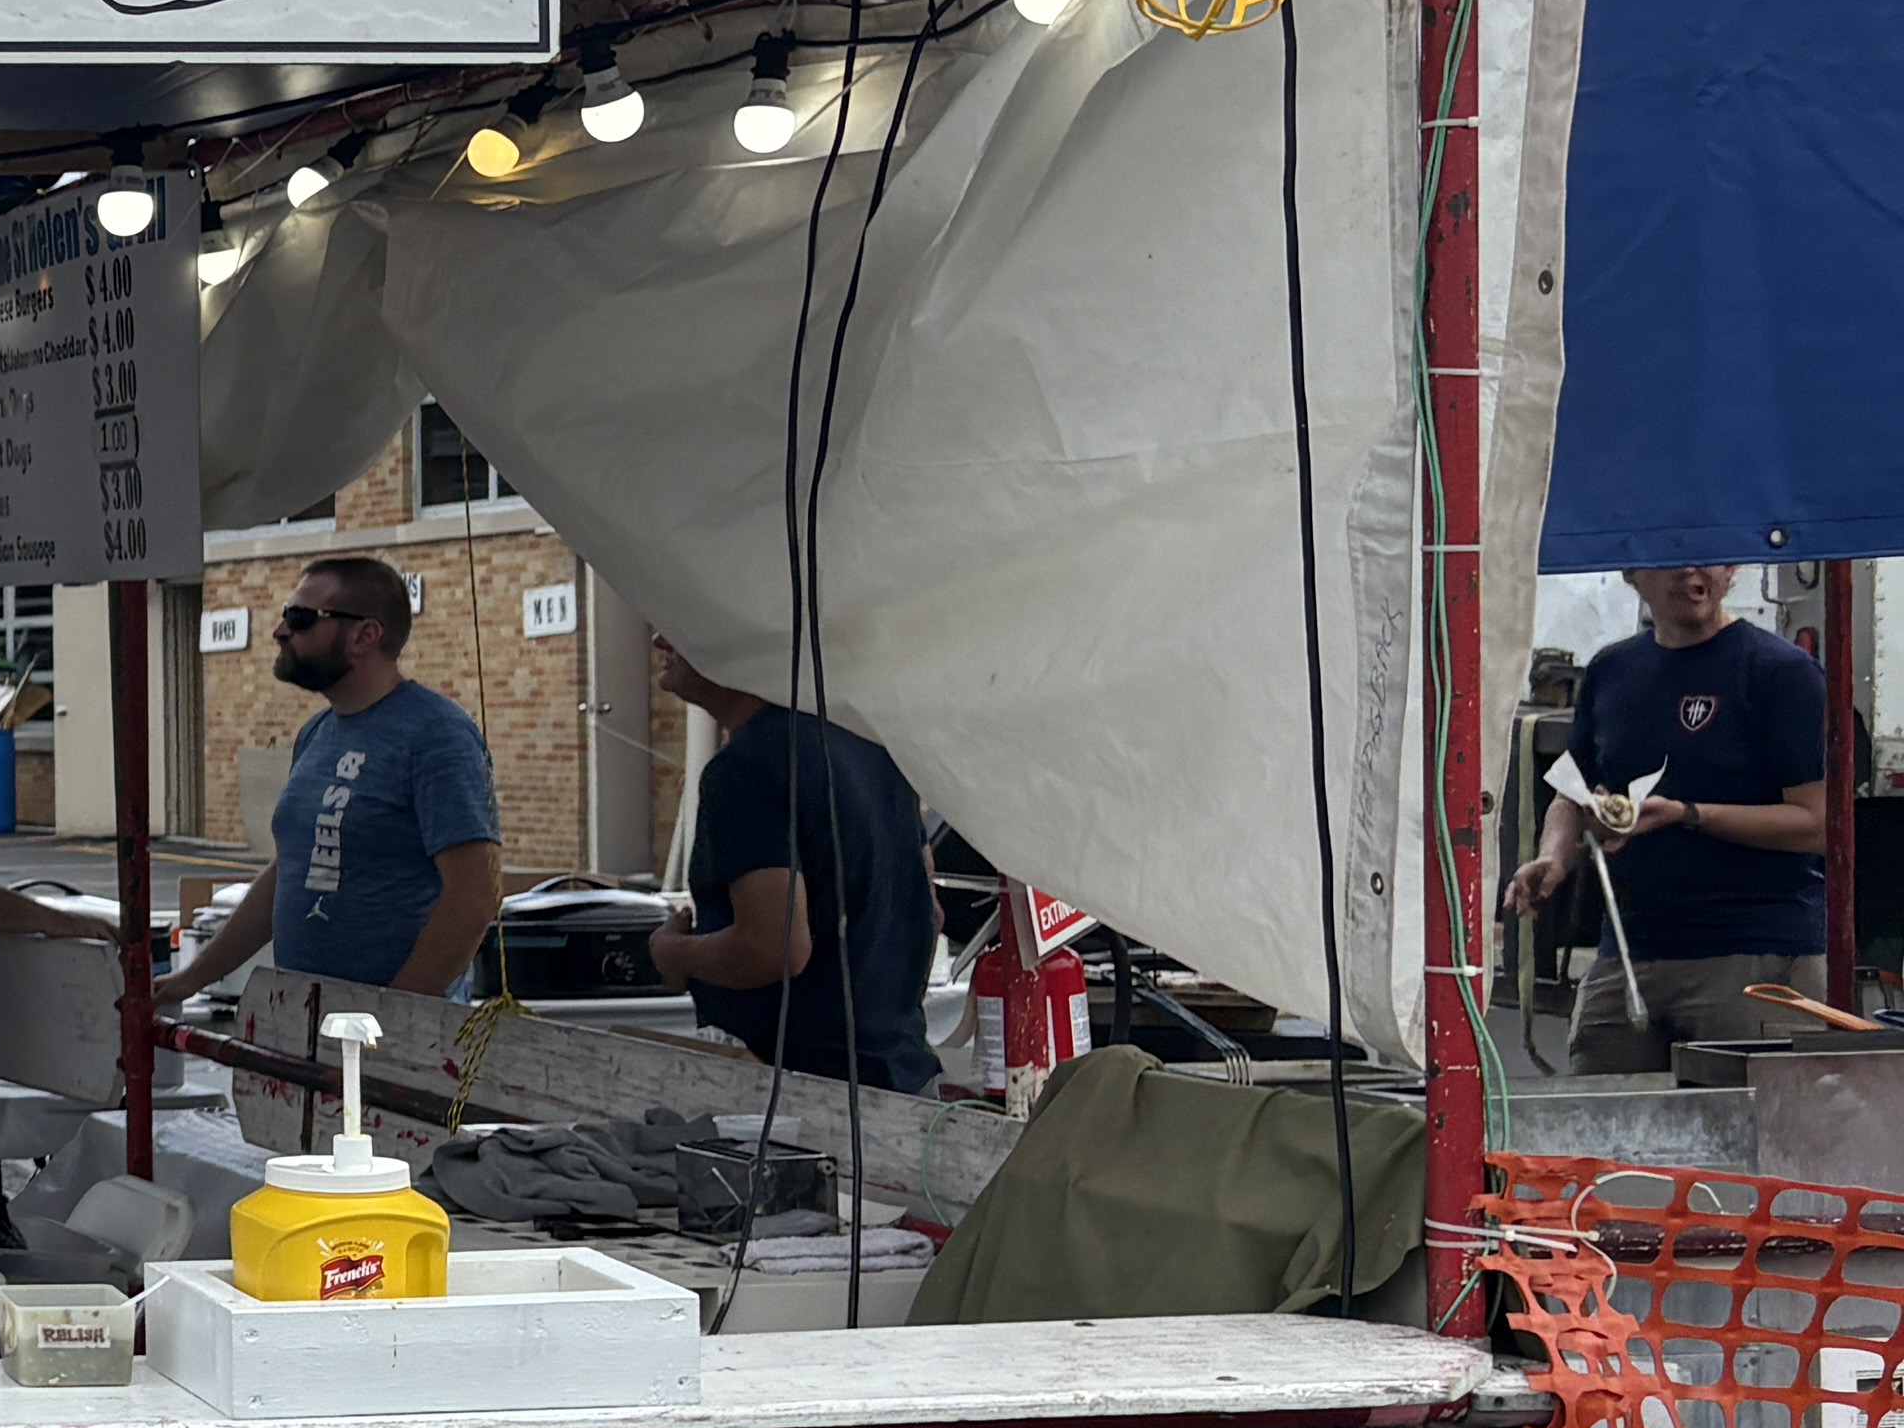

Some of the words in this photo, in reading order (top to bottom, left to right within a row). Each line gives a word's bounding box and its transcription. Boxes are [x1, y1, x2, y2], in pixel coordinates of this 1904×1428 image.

[15, 285, 55, 323] Burgers
[44, 335, 88, 364] Cheddar
[323, 1260, 381, 1290] French's
[43, 1327, 106, 1344] RELISH
